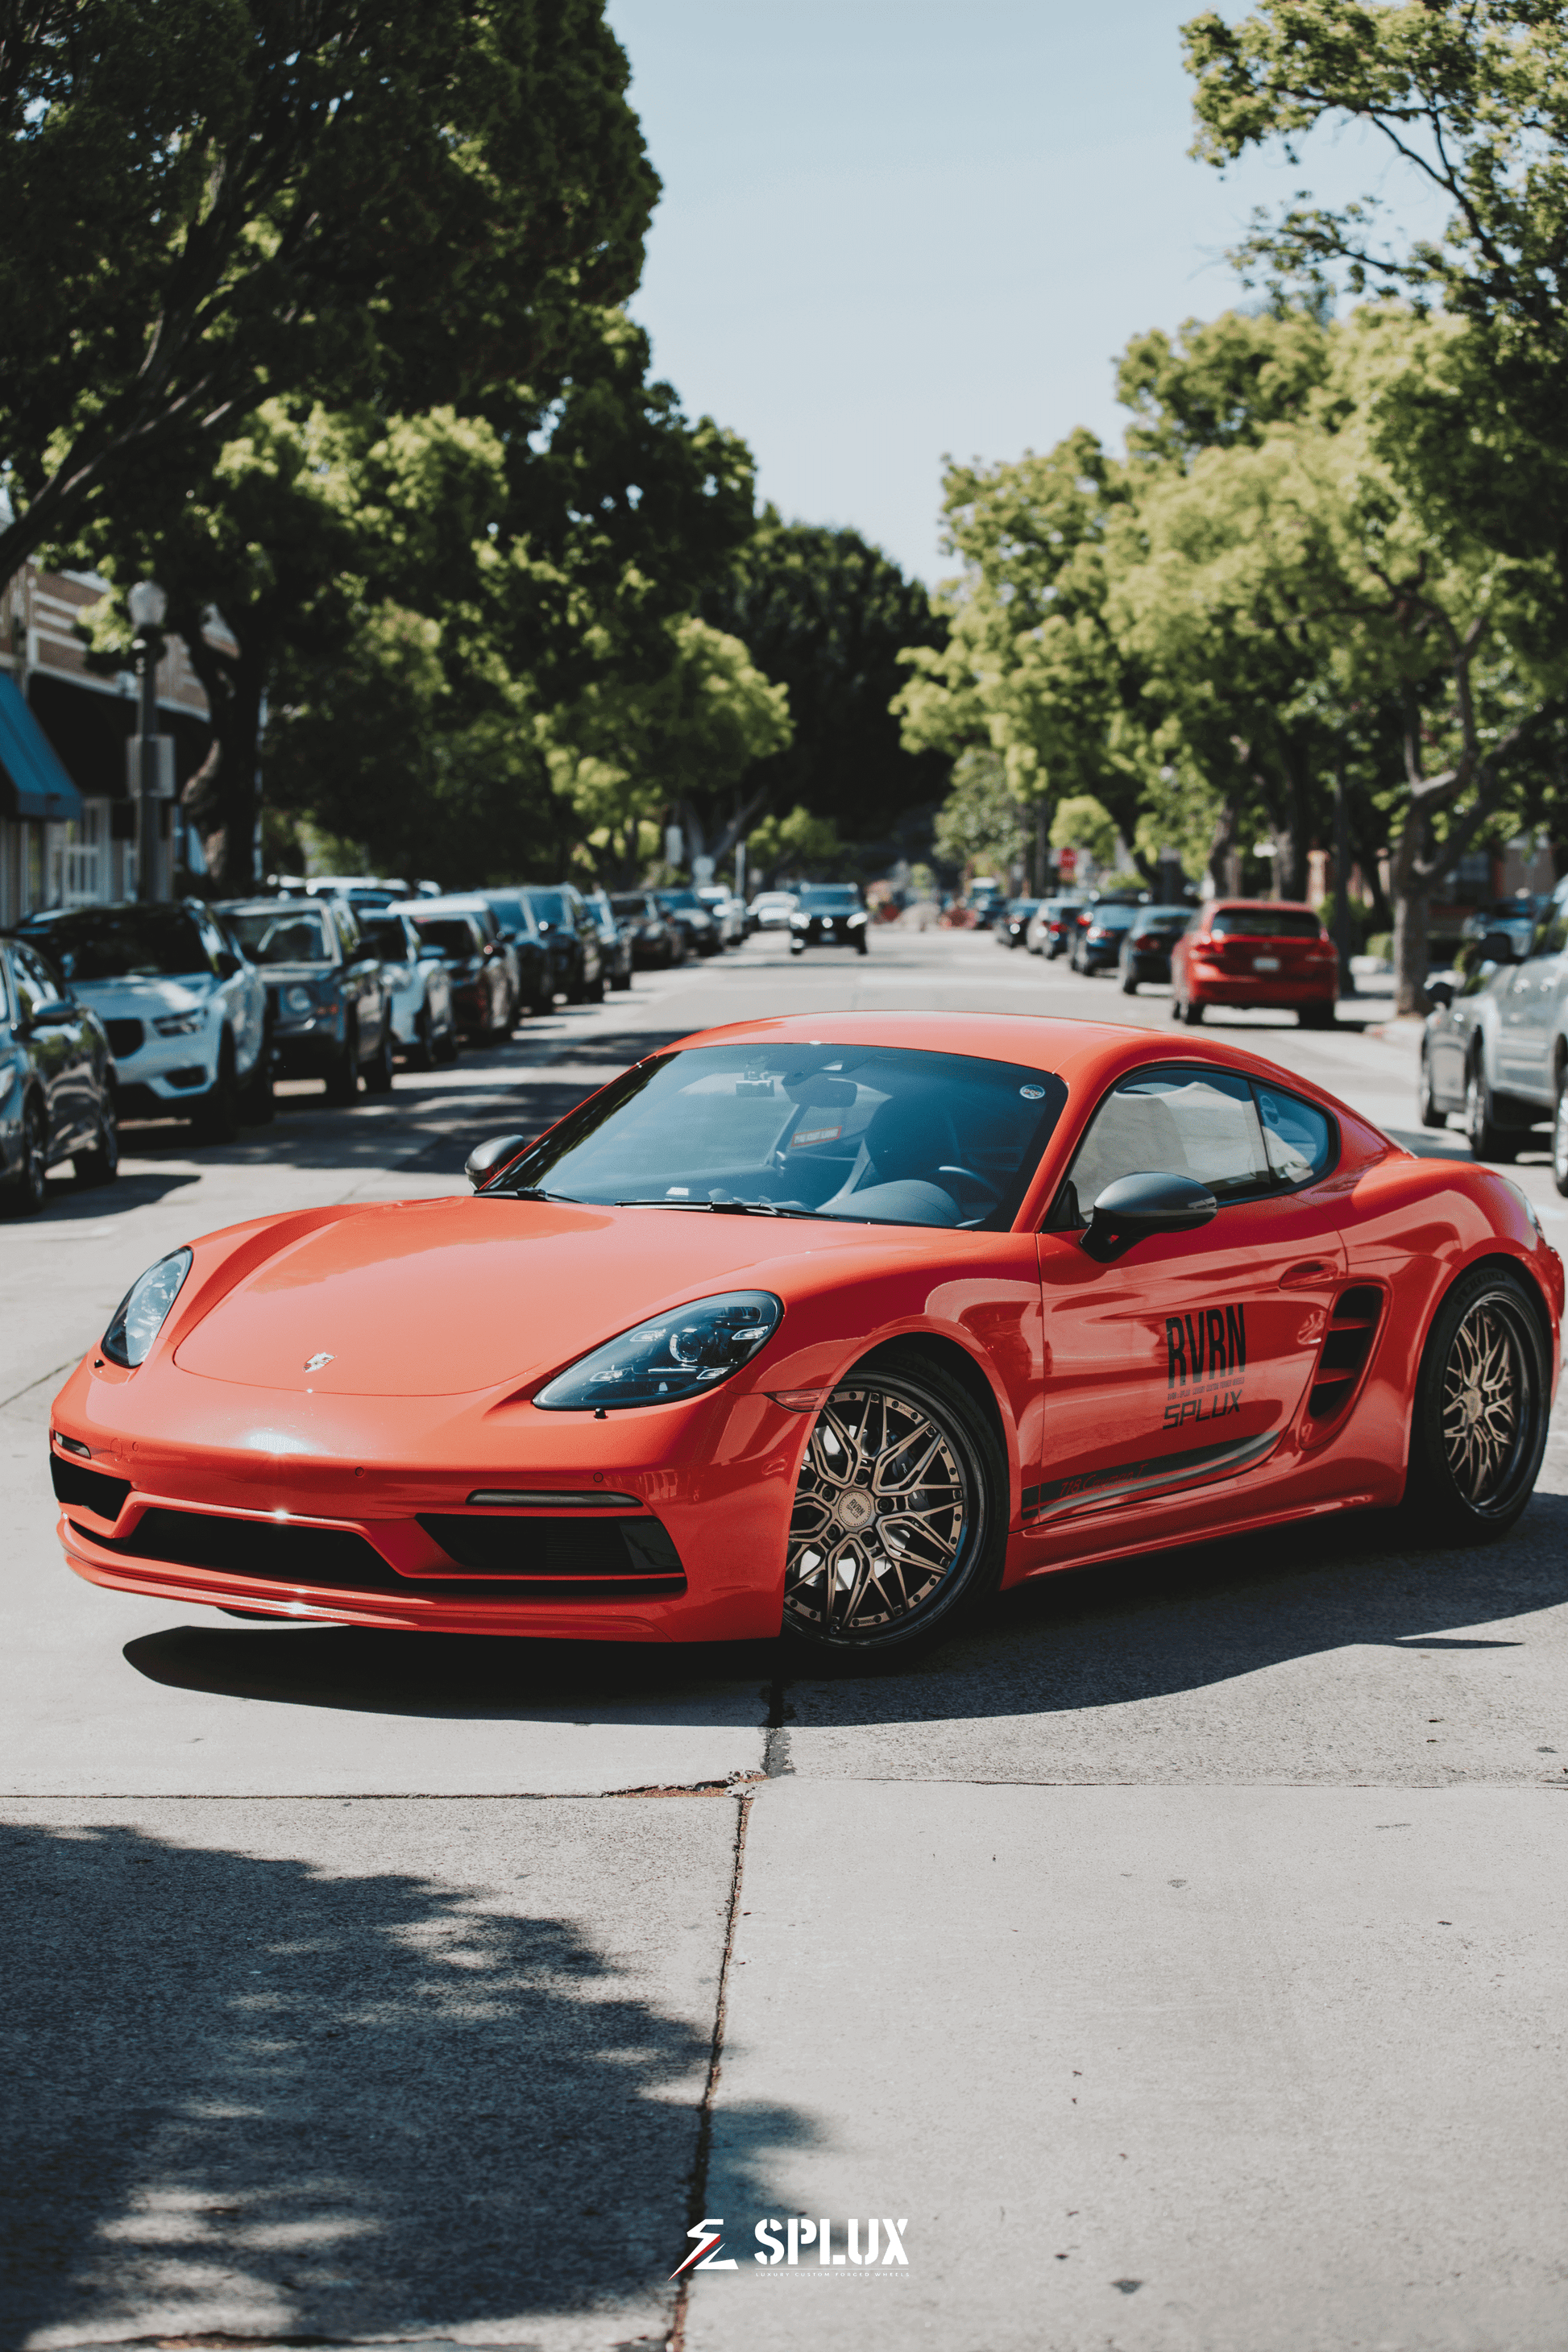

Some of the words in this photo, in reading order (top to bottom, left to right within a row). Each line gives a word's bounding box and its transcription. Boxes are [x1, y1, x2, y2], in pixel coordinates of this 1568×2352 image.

[1165, 1303, 1247, 1389] RVRN
[1162, 1388, 1242, 1430] SPLUX
[1060, 1479, 1082, 1496] 718
[1082, 1471, 1135, 1494] Cayman
[1137, 1462, 1149, 1478] T
[848, 1499, 865, 1516] RVRN
